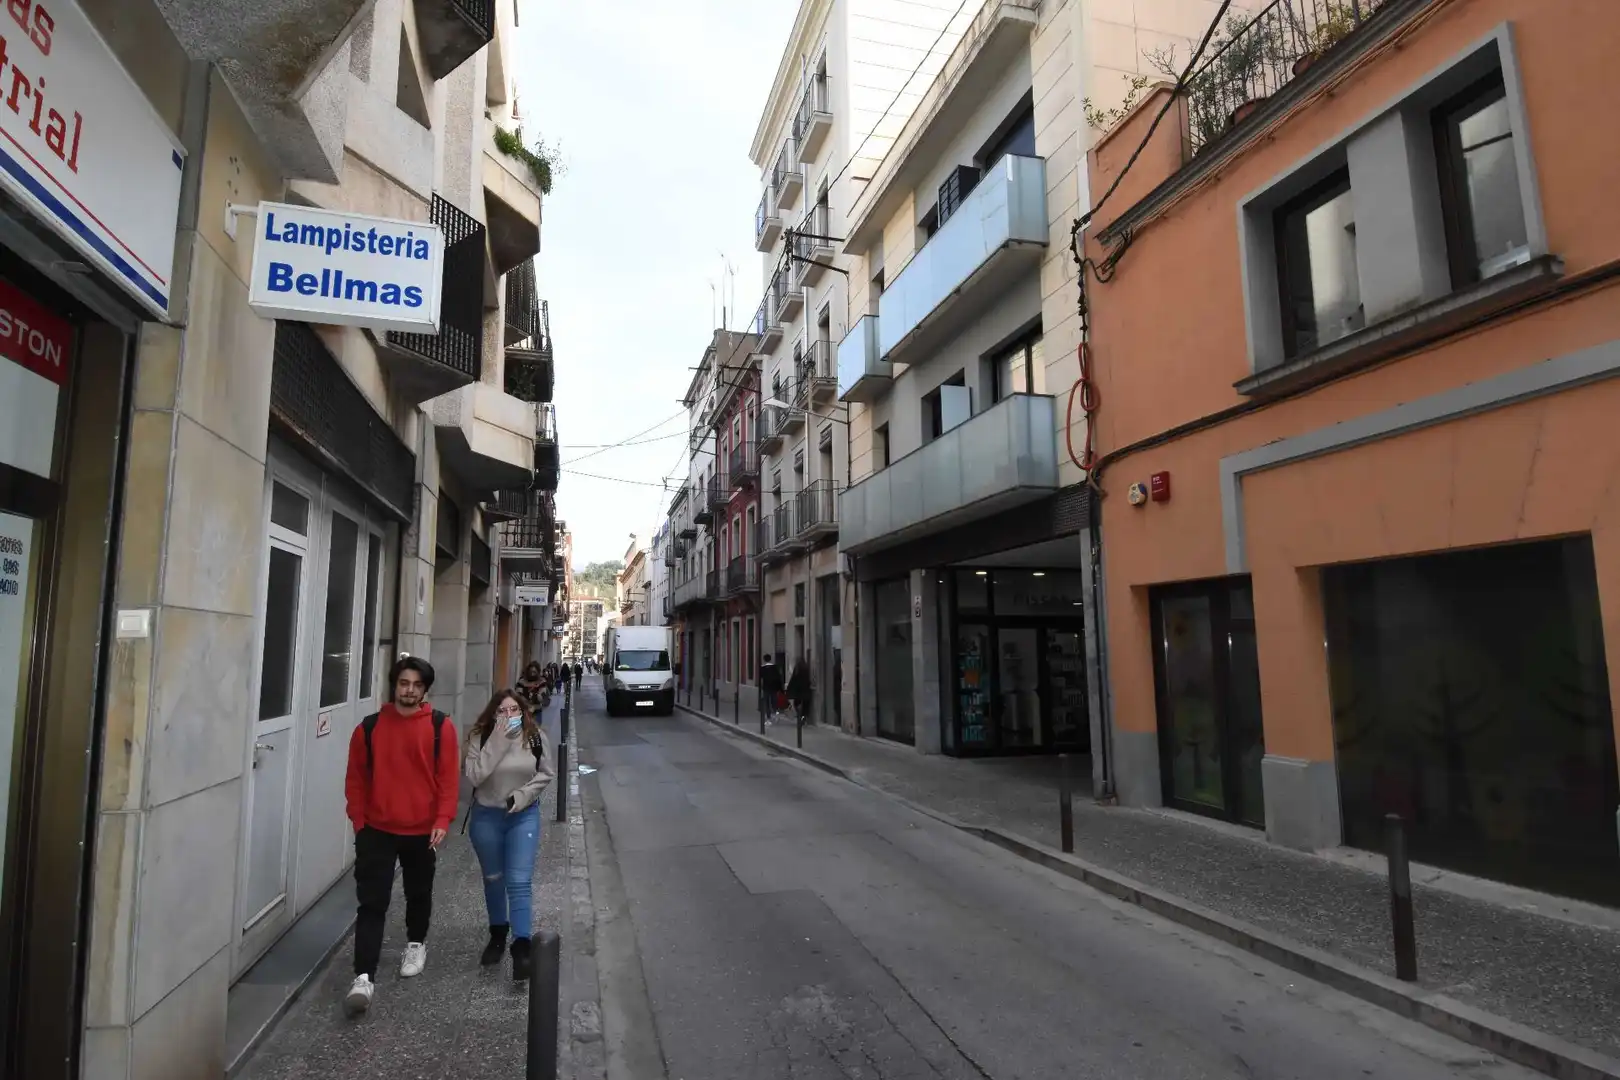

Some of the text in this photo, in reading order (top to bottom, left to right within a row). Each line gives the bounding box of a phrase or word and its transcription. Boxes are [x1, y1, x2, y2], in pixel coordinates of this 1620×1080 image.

[0, 0, 55, 56] as
[265, 212, 429, 260] Lampisteria
[267, 262, 423, 308] Bellmas
